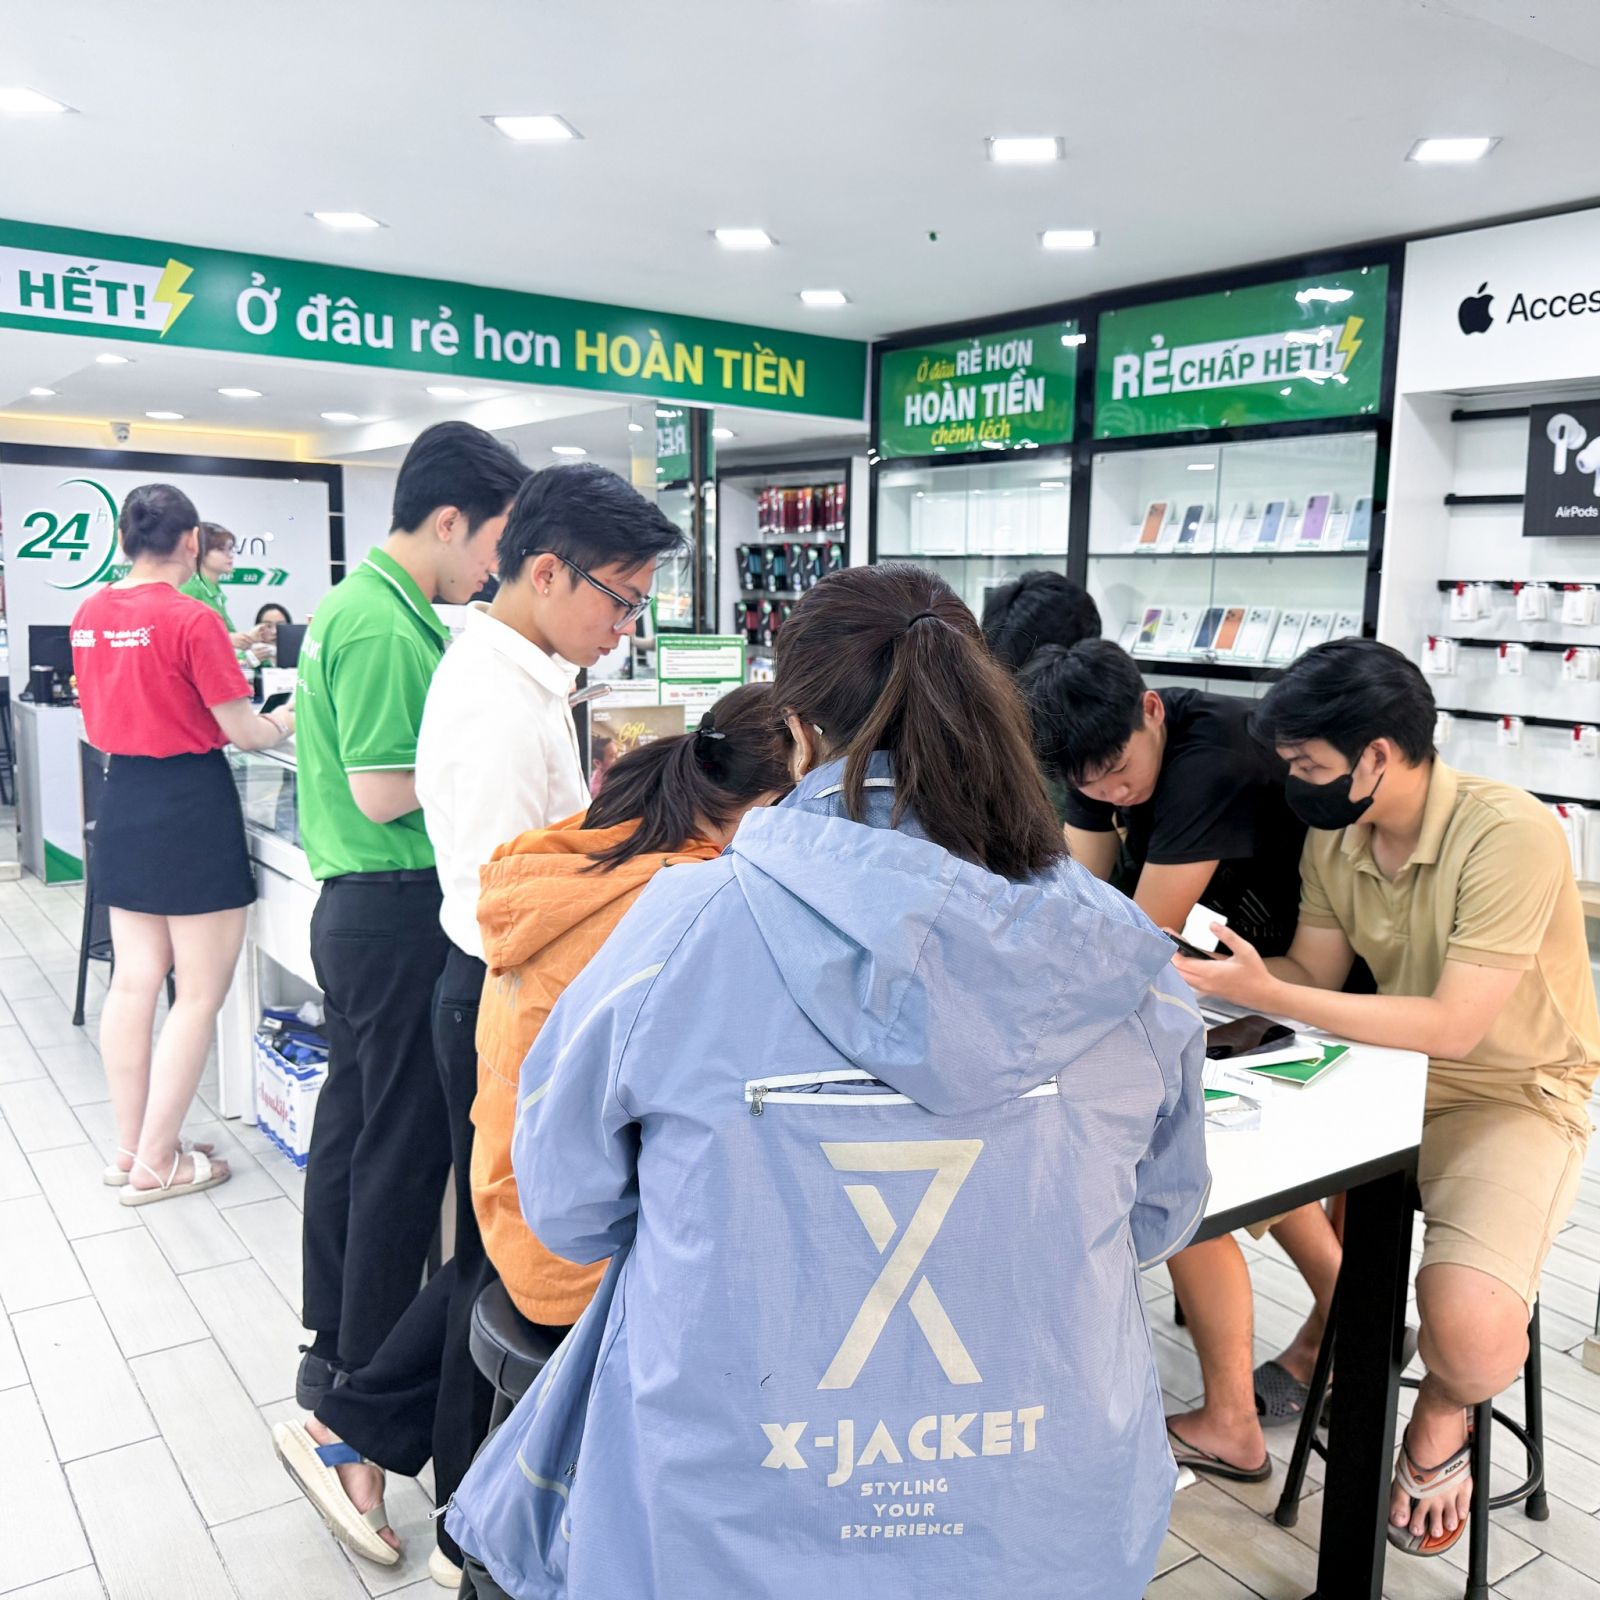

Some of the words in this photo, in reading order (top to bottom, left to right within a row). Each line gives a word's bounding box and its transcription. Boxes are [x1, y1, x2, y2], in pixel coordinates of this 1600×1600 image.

[19, 265, 145, 319] HẾT!
[236, 271, 281, 335] Ở
[296, 293, 394, 349] đâu
[410, 305, 459, 356] rẻ
[474, 313, 561, 369] hơn
[575, 328, 704, 386] HOÀN
[713, 341, 805, 397] TIỀN
[985, 339, 1033, 373] HƠN
[1112, 334, 1171, 400] RẺ
[1179, 344, 1254, 386] CHẤP
[904, 381, 977, 427] HOÀN
[981, 368, 1046, 418] TIỀN
[1555, 505, 1599, 518] AirPods
[760, 1405, 1045, 1488] X-JACKET
[860, 1477, 949, 1497] STYLING
[840, 1522, 965, 1539] EXPERIENCE
[872, 1502, 935, 1518] YOUR
